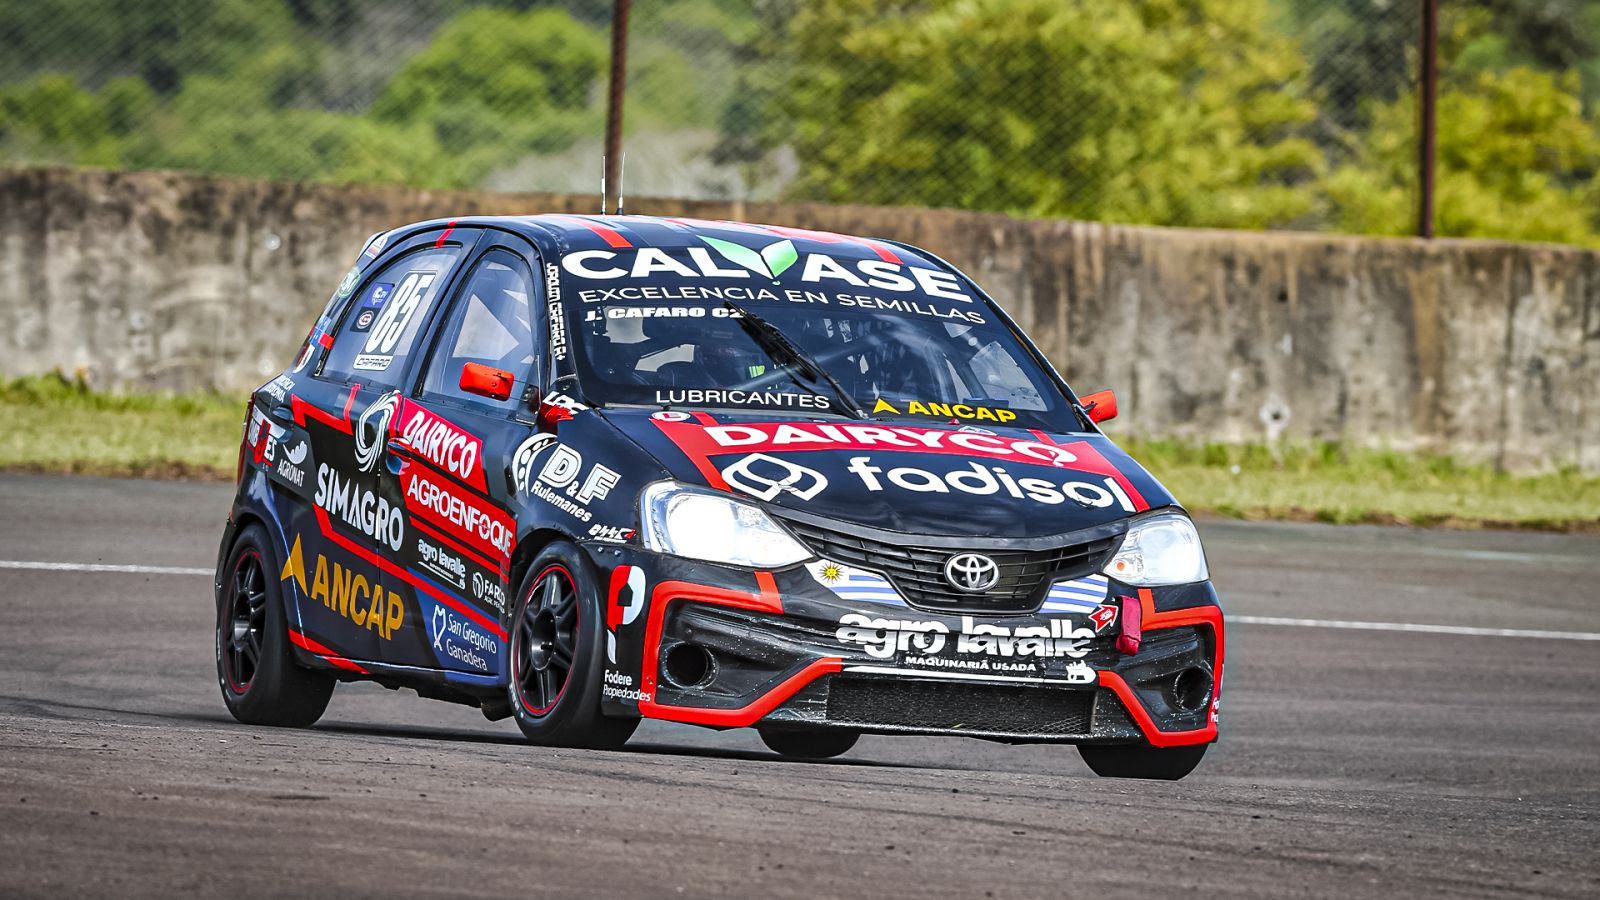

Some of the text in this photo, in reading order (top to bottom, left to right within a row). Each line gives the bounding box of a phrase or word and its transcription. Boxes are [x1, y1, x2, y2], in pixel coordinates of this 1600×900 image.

[365, 273, 437, 354] 85
[578, 286, 986, 325] EXCELENCIA EN SEMILLAS
[608, 307, 706, 319] CAFARO
[656, 390, 830, 409] LUBRICANTES
[908, 400, 1017, 423] ANCAP
[399, 410, 478, 479] DAIRYCO
[704, 425, 1078, 466] DAIRYCO
[277, 459, 305, 487] AGRONAT
[538, 443, 622, 506] D&F
[847, 456, 1137, 513] fadisol
[314, 462, 404, 552] SIMAGRO
[407, 474, 513, 558] AGROENFOQUE
[530, 480, 593, 522] Rulemanes
[418, 538, 438, 562] agro
[438, 547, 466, 579] lavalle
[311, 553, 405, 641] ANCAP
[448, 613, 497, 654] San Gregorio
[835, 613, 1096, 658] agro lavalle
[446, 639, 488, 671] Ganadera
[992, 662, 1037, 671] USADA
[603, 683, 651, 702] Propiedades
[604, 669, 633, 686] Fodere
